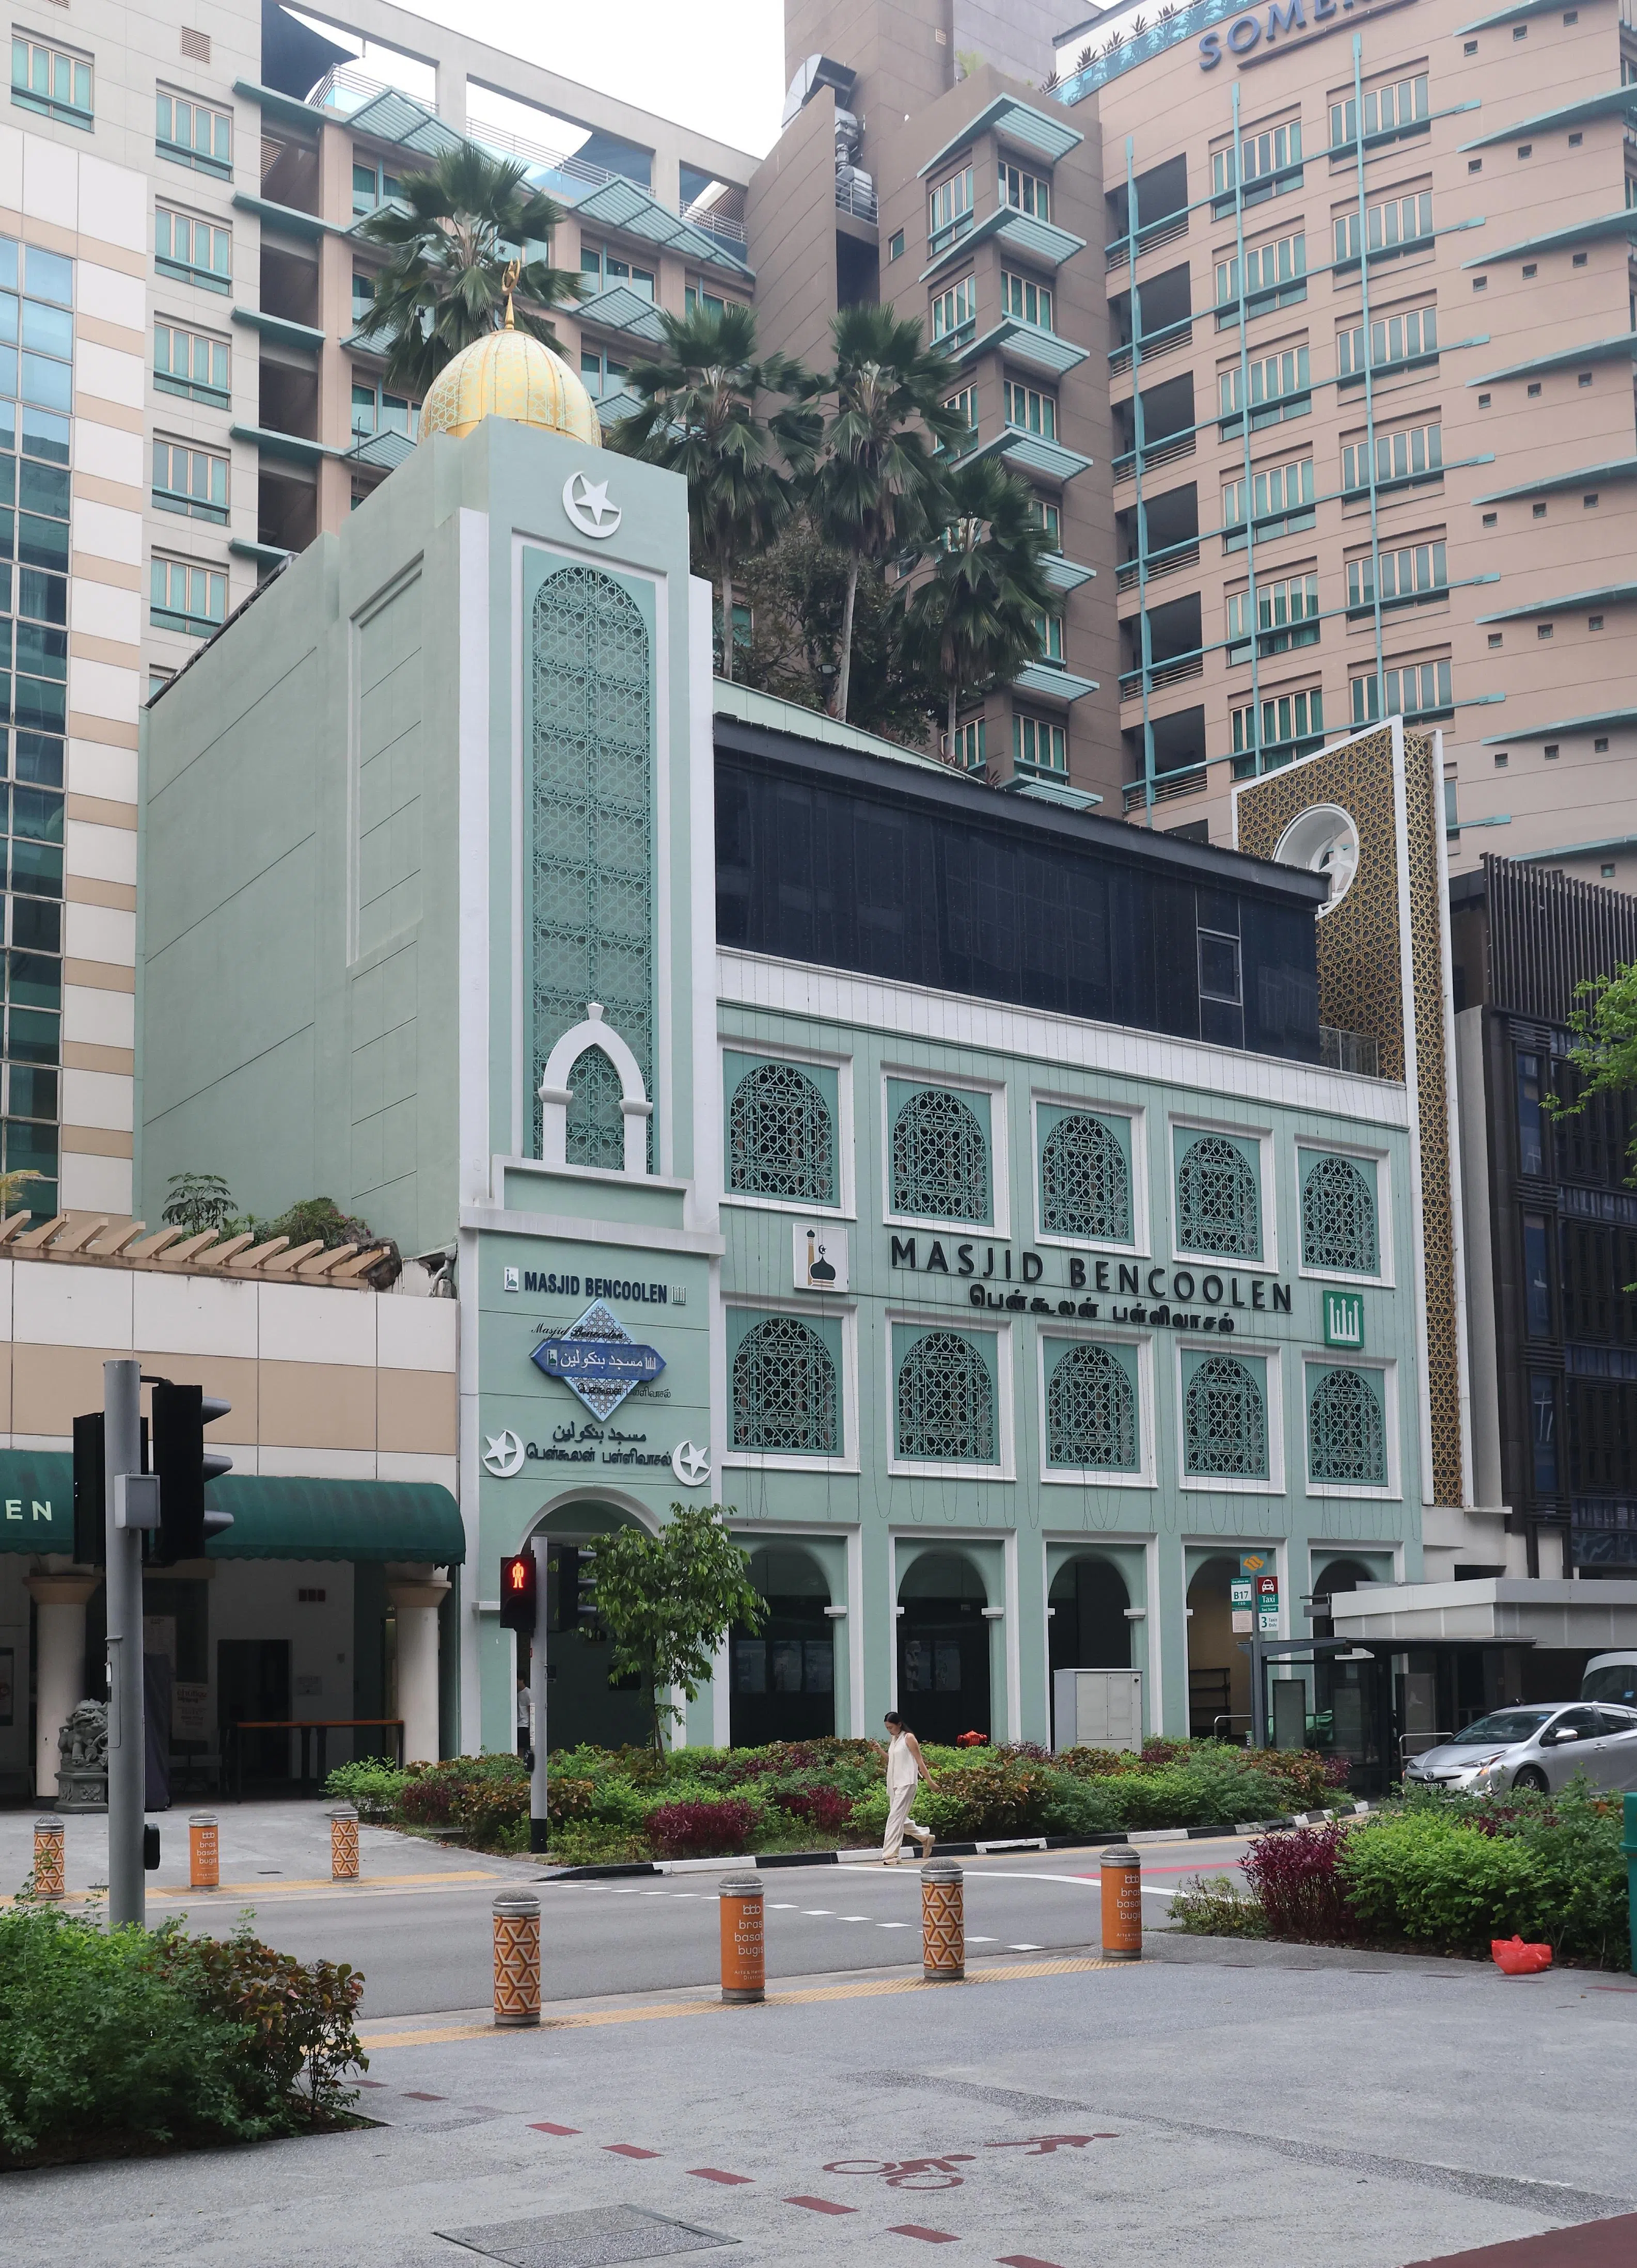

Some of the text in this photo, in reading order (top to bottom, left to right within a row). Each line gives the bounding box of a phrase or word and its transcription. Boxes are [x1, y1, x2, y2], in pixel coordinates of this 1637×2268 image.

[891, 1235, 1292, 1311] MASJID BENCOOLEN
[525, 1272, 667, 1303] MASJID BENCOOLEN
[531, 1322, 570, 1338] Masjid
[609, 1355, 643, 1370] مسجد
[608, 1428, 647, 1445] مسجد
[5, 1499, 52, 1521] EN
[1234, 1591, 1249, 1599] B17
[1262, 1595, 1276, 1603] Taxi
[1261, 1616, 1267, 1628] 3
[1121, 1888, 1140, 1897] bras
[739, 1919, 762, 1929] bras
[738, 1944, 764, 1957] bugis
